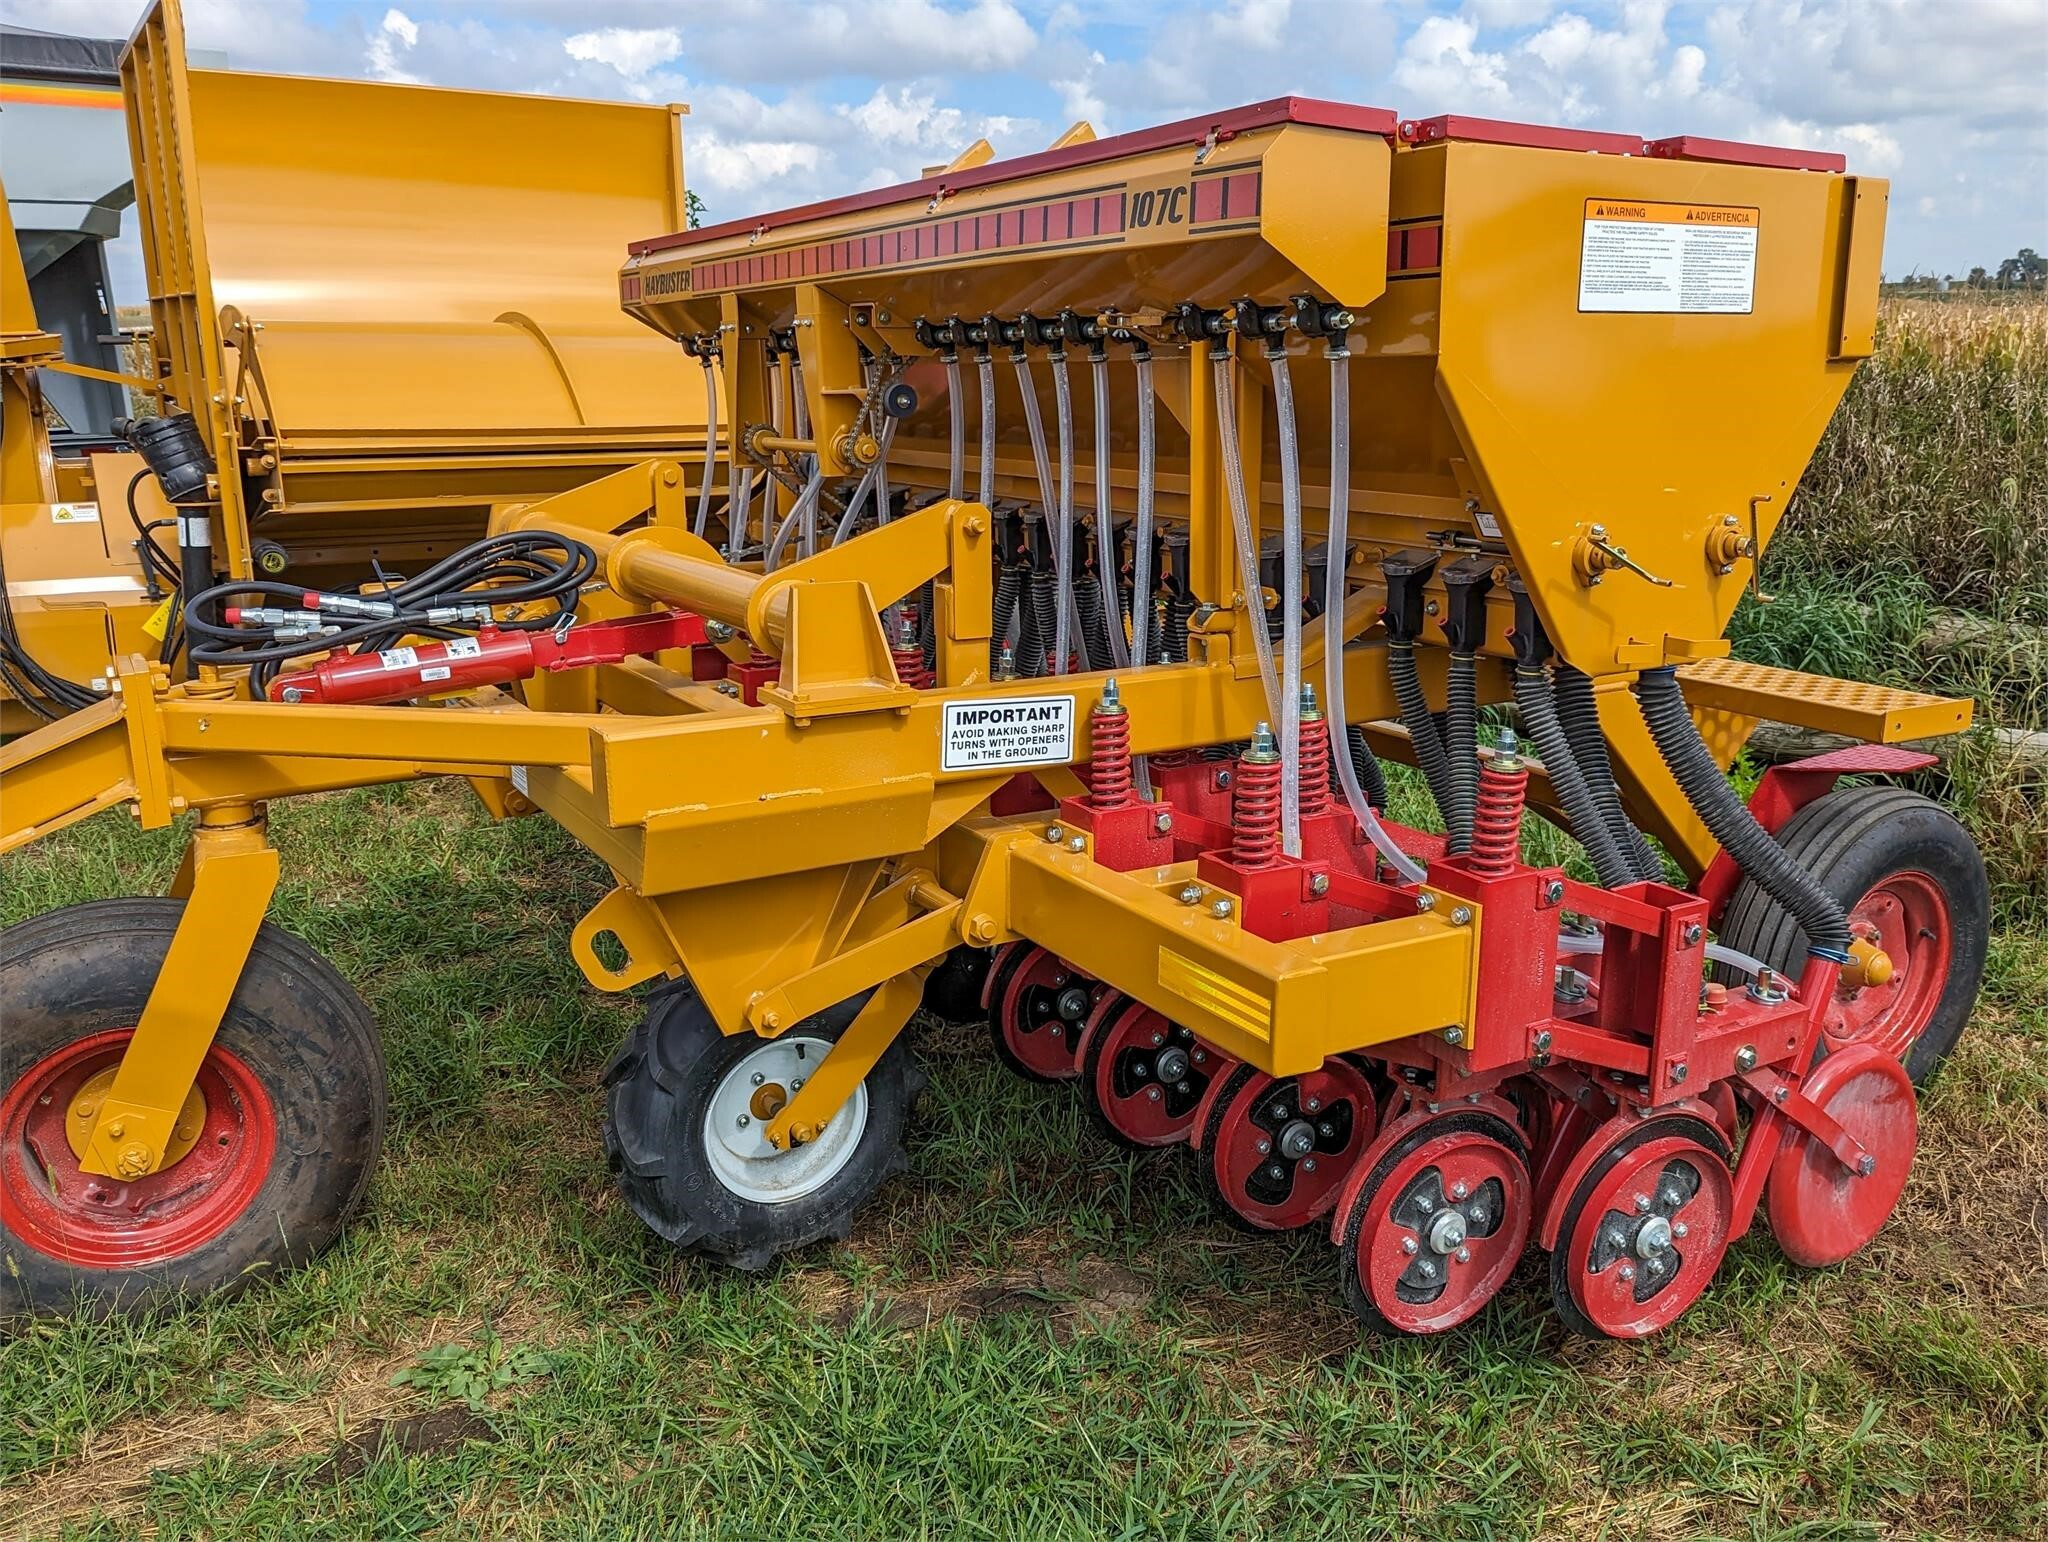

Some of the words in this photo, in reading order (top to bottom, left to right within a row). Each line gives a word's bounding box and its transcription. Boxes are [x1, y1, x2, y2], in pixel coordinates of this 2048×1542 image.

[1130, 186, 1187, 228] 107C
[1606, 206, 1646, 218] WARNING
[1695, 211, 1749, 223] ADVERTENCIA
[645, 270, 690, 296] HAYBUSTER
[956, 706, 1062, 726] IMPORTANT
[952, 729, 984, 739] AVOID
[988, 726, 1028, 736] MAKING
[1031, 724, 1065, 734] SHARP
[950, 740, 986, 750] TURNS
[989, 738, 1014, 748] WITH
[1018, 734, 1065, 746] OPENERS
[968, 752, 978, 760] IN
[983, 750, 1001, 759] THE
[1005, 747, 1048, 758] GROUND
